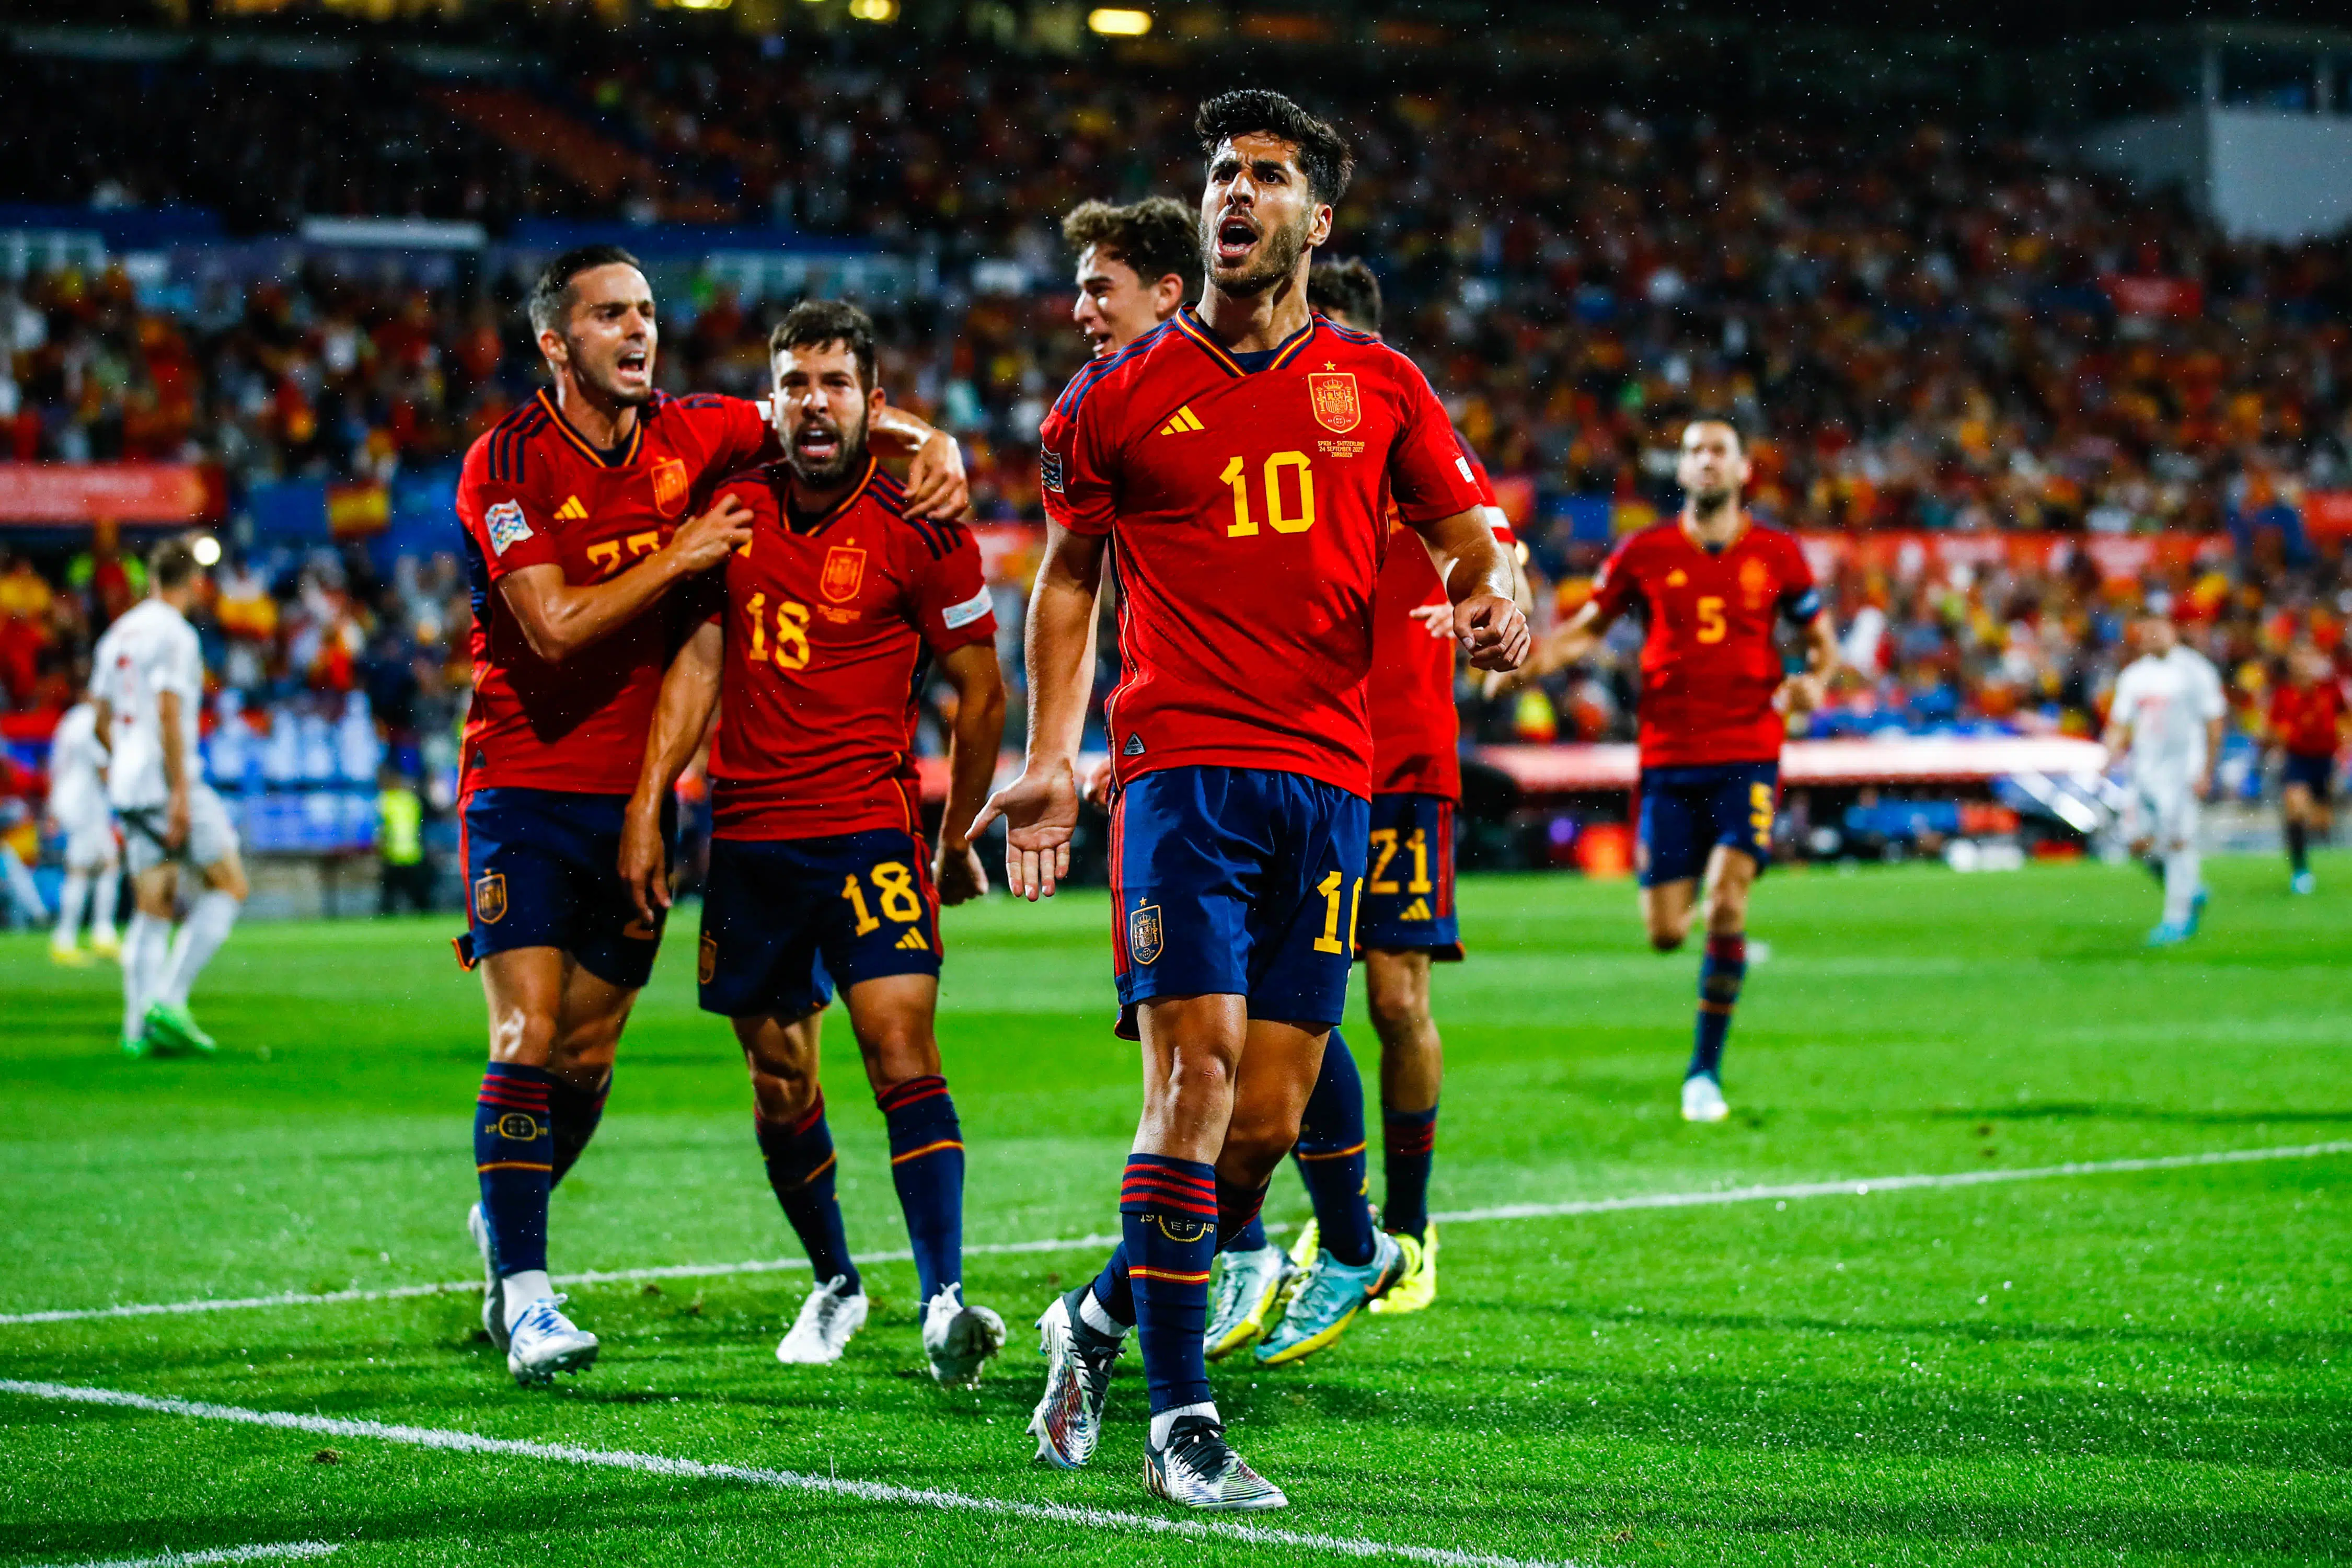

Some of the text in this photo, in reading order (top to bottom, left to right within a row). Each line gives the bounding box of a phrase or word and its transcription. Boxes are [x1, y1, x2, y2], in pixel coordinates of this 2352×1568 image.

[1219, 451, 1315, 537] 10
[586, 531, 661, 574] 2
[746, 592, 810, 671] 18
[1697, 596, 1727, 644] 5
[840, 861, 922, 937] 18
[1369, 828, 1433, 894] 21
[1313, 871, 1364, 959] 1
